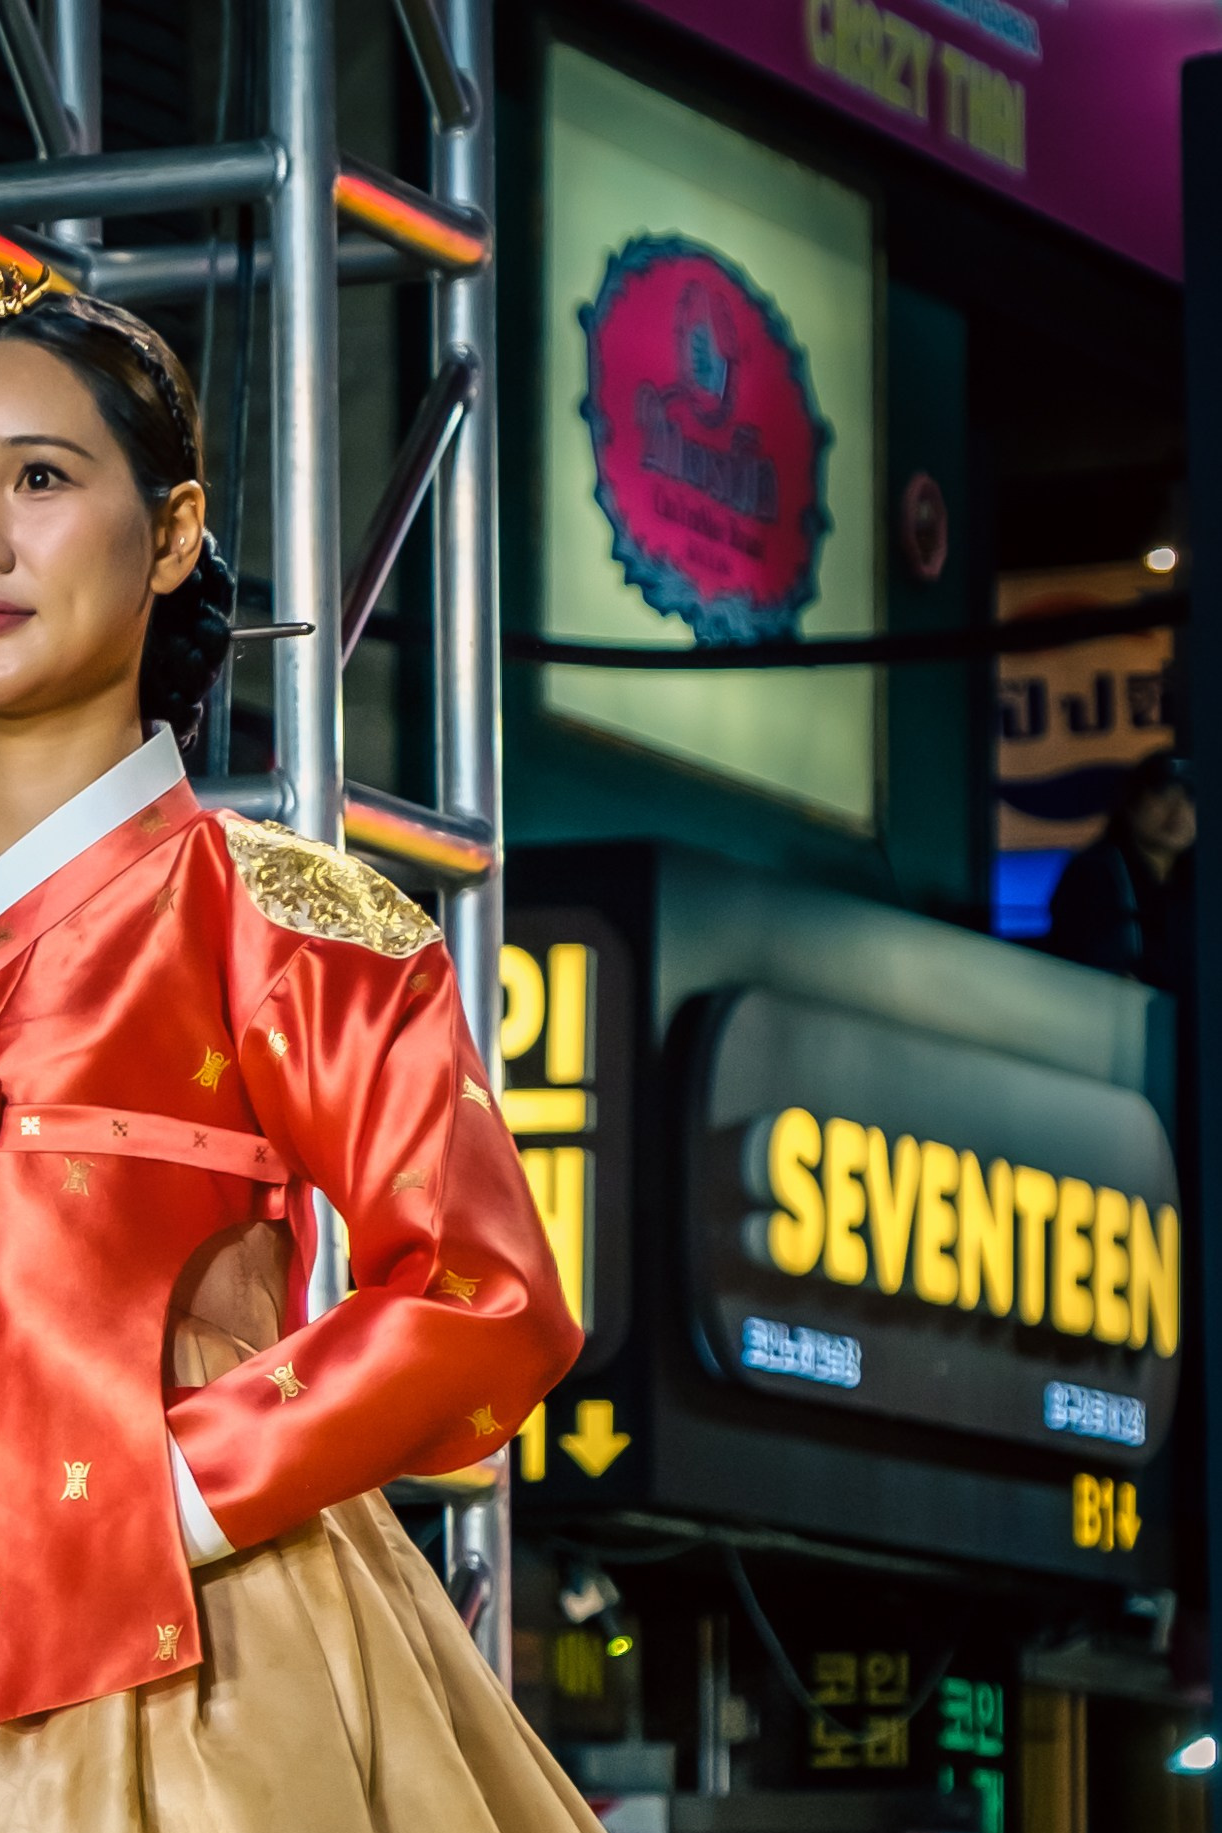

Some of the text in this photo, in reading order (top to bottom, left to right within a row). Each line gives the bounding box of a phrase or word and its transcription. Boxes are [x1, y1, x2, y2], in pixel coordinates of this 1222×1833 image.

[768, 1107, 1180, 1359] SEVENTEEN
[1073, 1472, 1115, 1552] B1
[812, 1650, 911, 1705] 코인
[937, 1675, 1005, 1758] 코인
[810, 1713, 910, 1770] 노래
